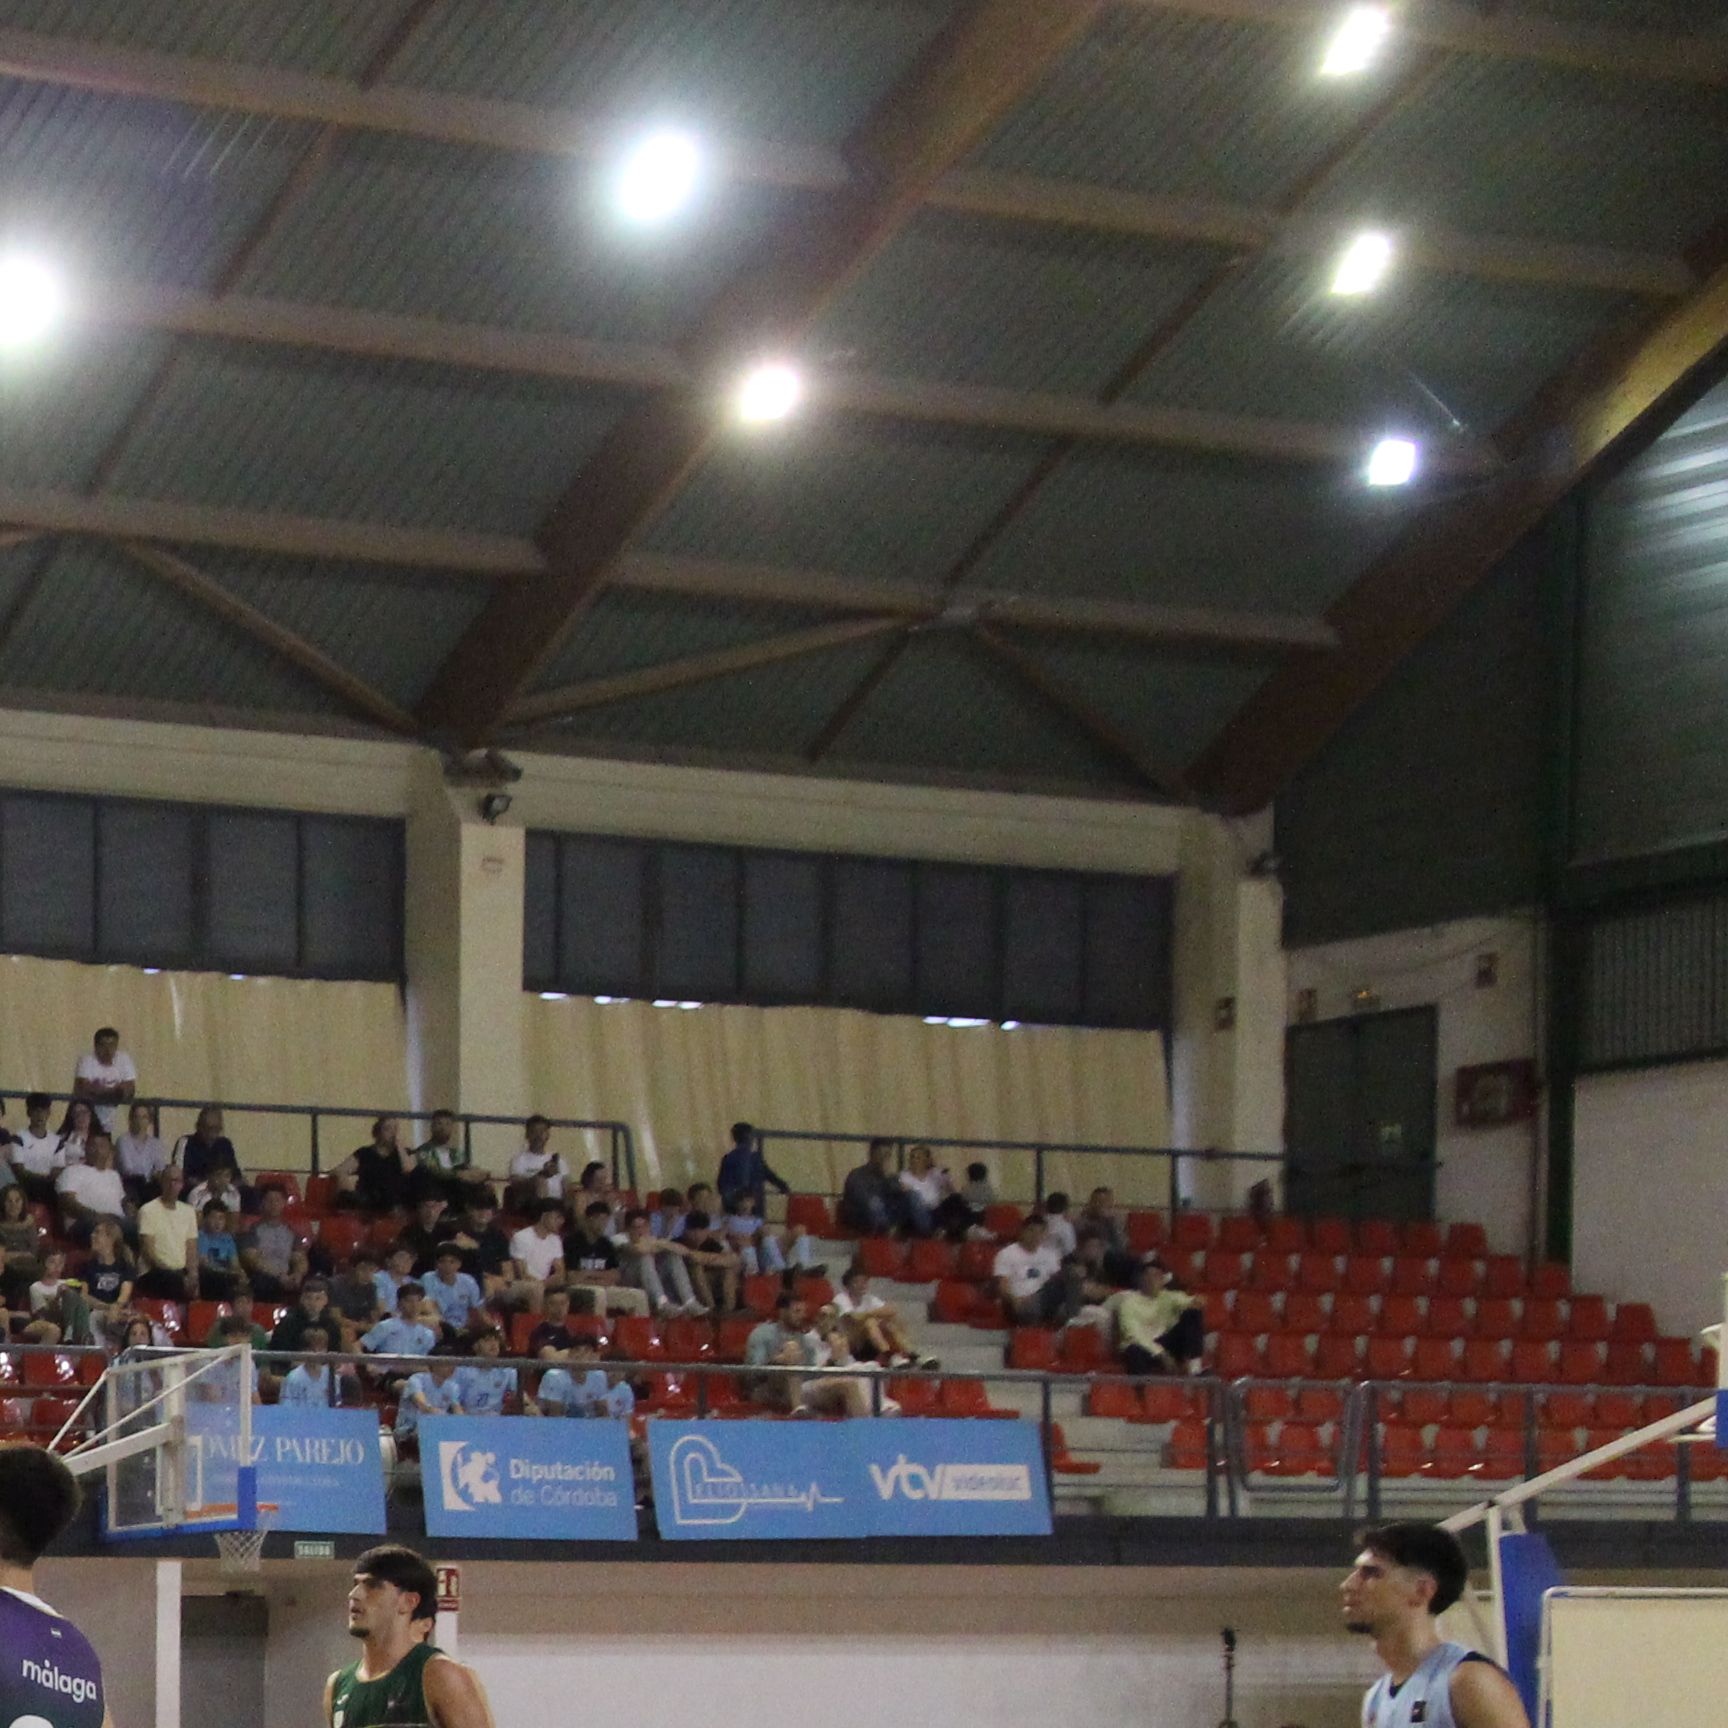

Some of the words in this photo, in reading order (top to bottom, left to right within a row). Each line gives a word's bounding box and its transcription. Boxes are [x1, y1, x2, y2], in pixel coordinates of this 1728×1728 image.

[275, 1436, 365, 1466] PAREJO
[509, 1459, 616, 1483] Diputación
[510, 1486, 535, 1504] de
[540, 1485, 618, 1507] Córdoba
